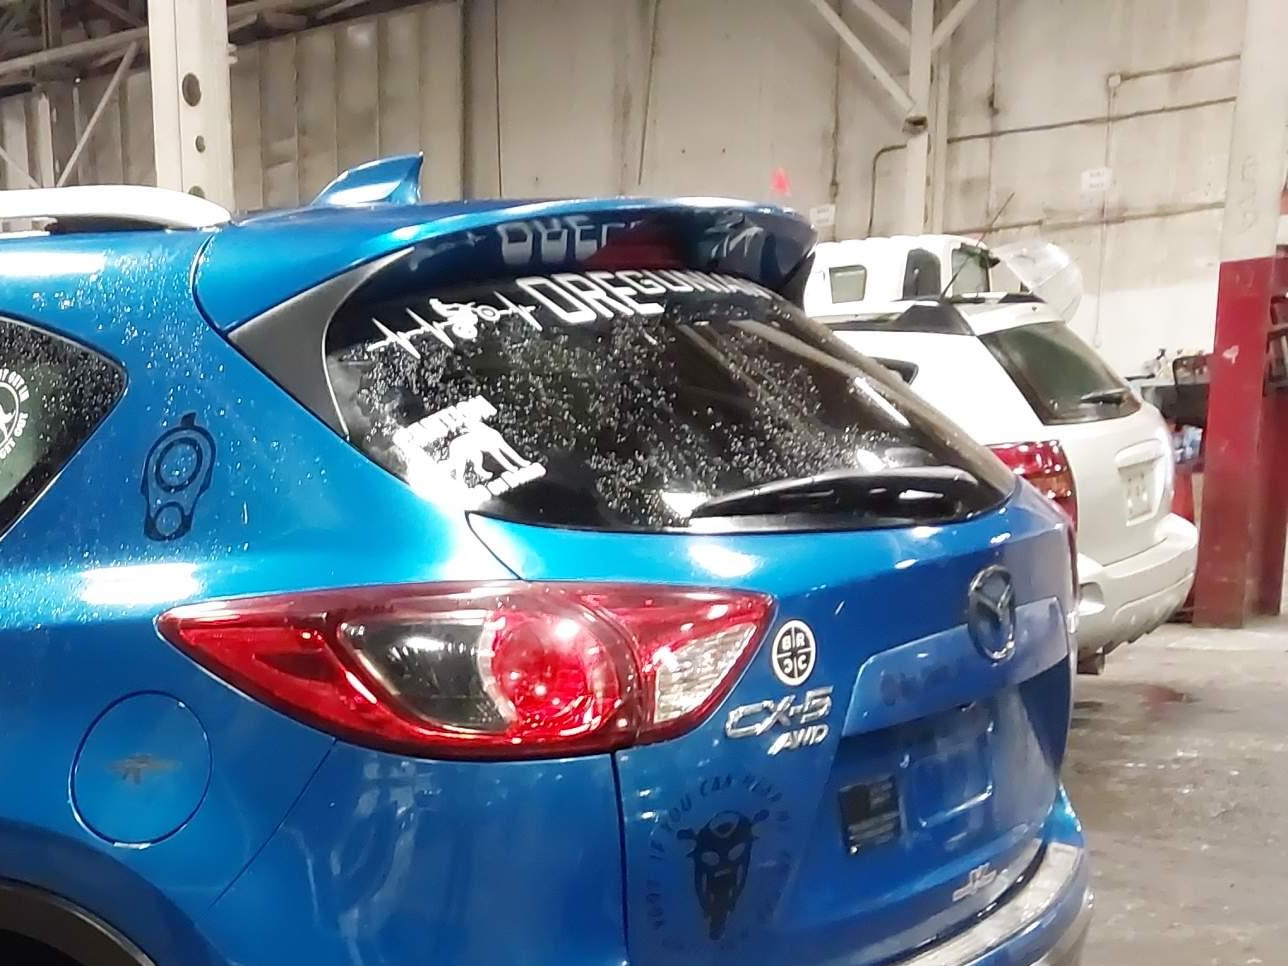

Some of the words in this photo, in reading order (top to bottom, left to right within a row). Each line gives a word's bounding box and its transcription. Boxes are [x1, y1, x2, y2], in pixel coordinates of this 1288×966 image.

[0, 438, 17, 459] GET
[14, 413, 29, 437] OUT
[725, 685, 834, 738] CX-5
[767, 724, 830, 755] AWD
